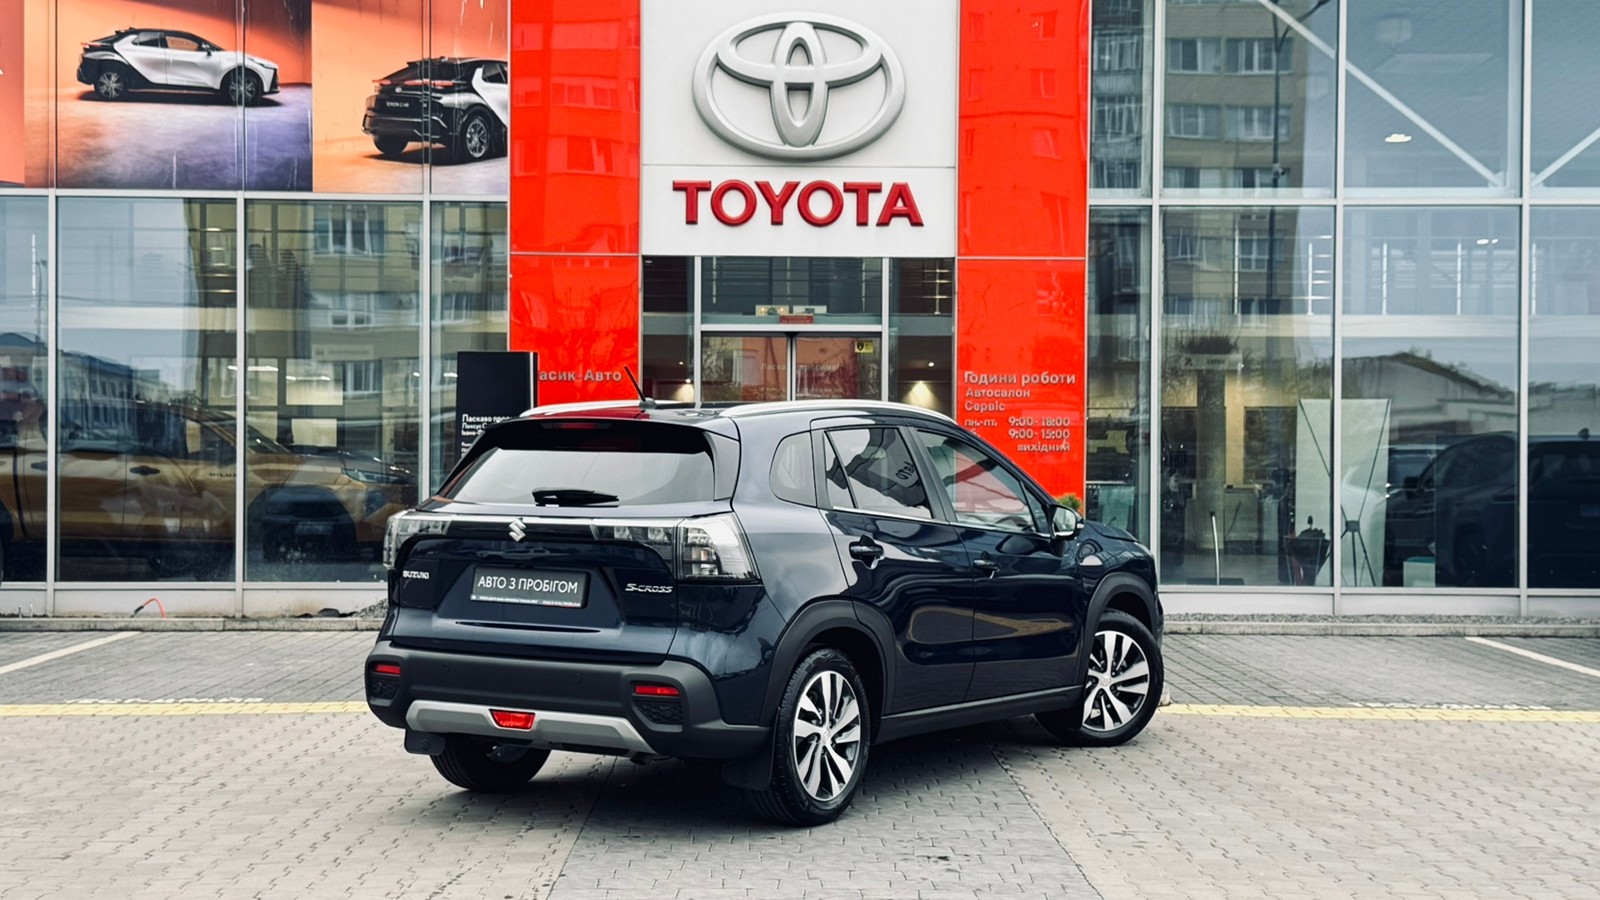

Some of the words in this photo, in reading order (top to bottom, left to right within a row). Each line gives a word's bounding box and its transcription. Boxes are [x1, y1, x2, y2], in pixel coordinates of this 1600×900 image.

[673, 179, 924, 227] TOYOTA
[538, 369, 623, 383] асик-Авто
[964, 371, 1017, 384] Години
[1021, 371, 1076, 386] роботи
[965, 388, 1031, 398] Автосалон
[964, 400, 1006, 413] Сервіс
[1041, 416, 1071, 427] 18:00
[1041, 428, 1071, 440] 15:00
[1017, 441, 1070, 452] вихідний
[402, 570, 430, 580] SUZUKI
[477, 576, 507, 589] АВТО
[518, 578, 578, 594] ПРОБІГОМ
[625, 582, 673, 594] S-CROSS
